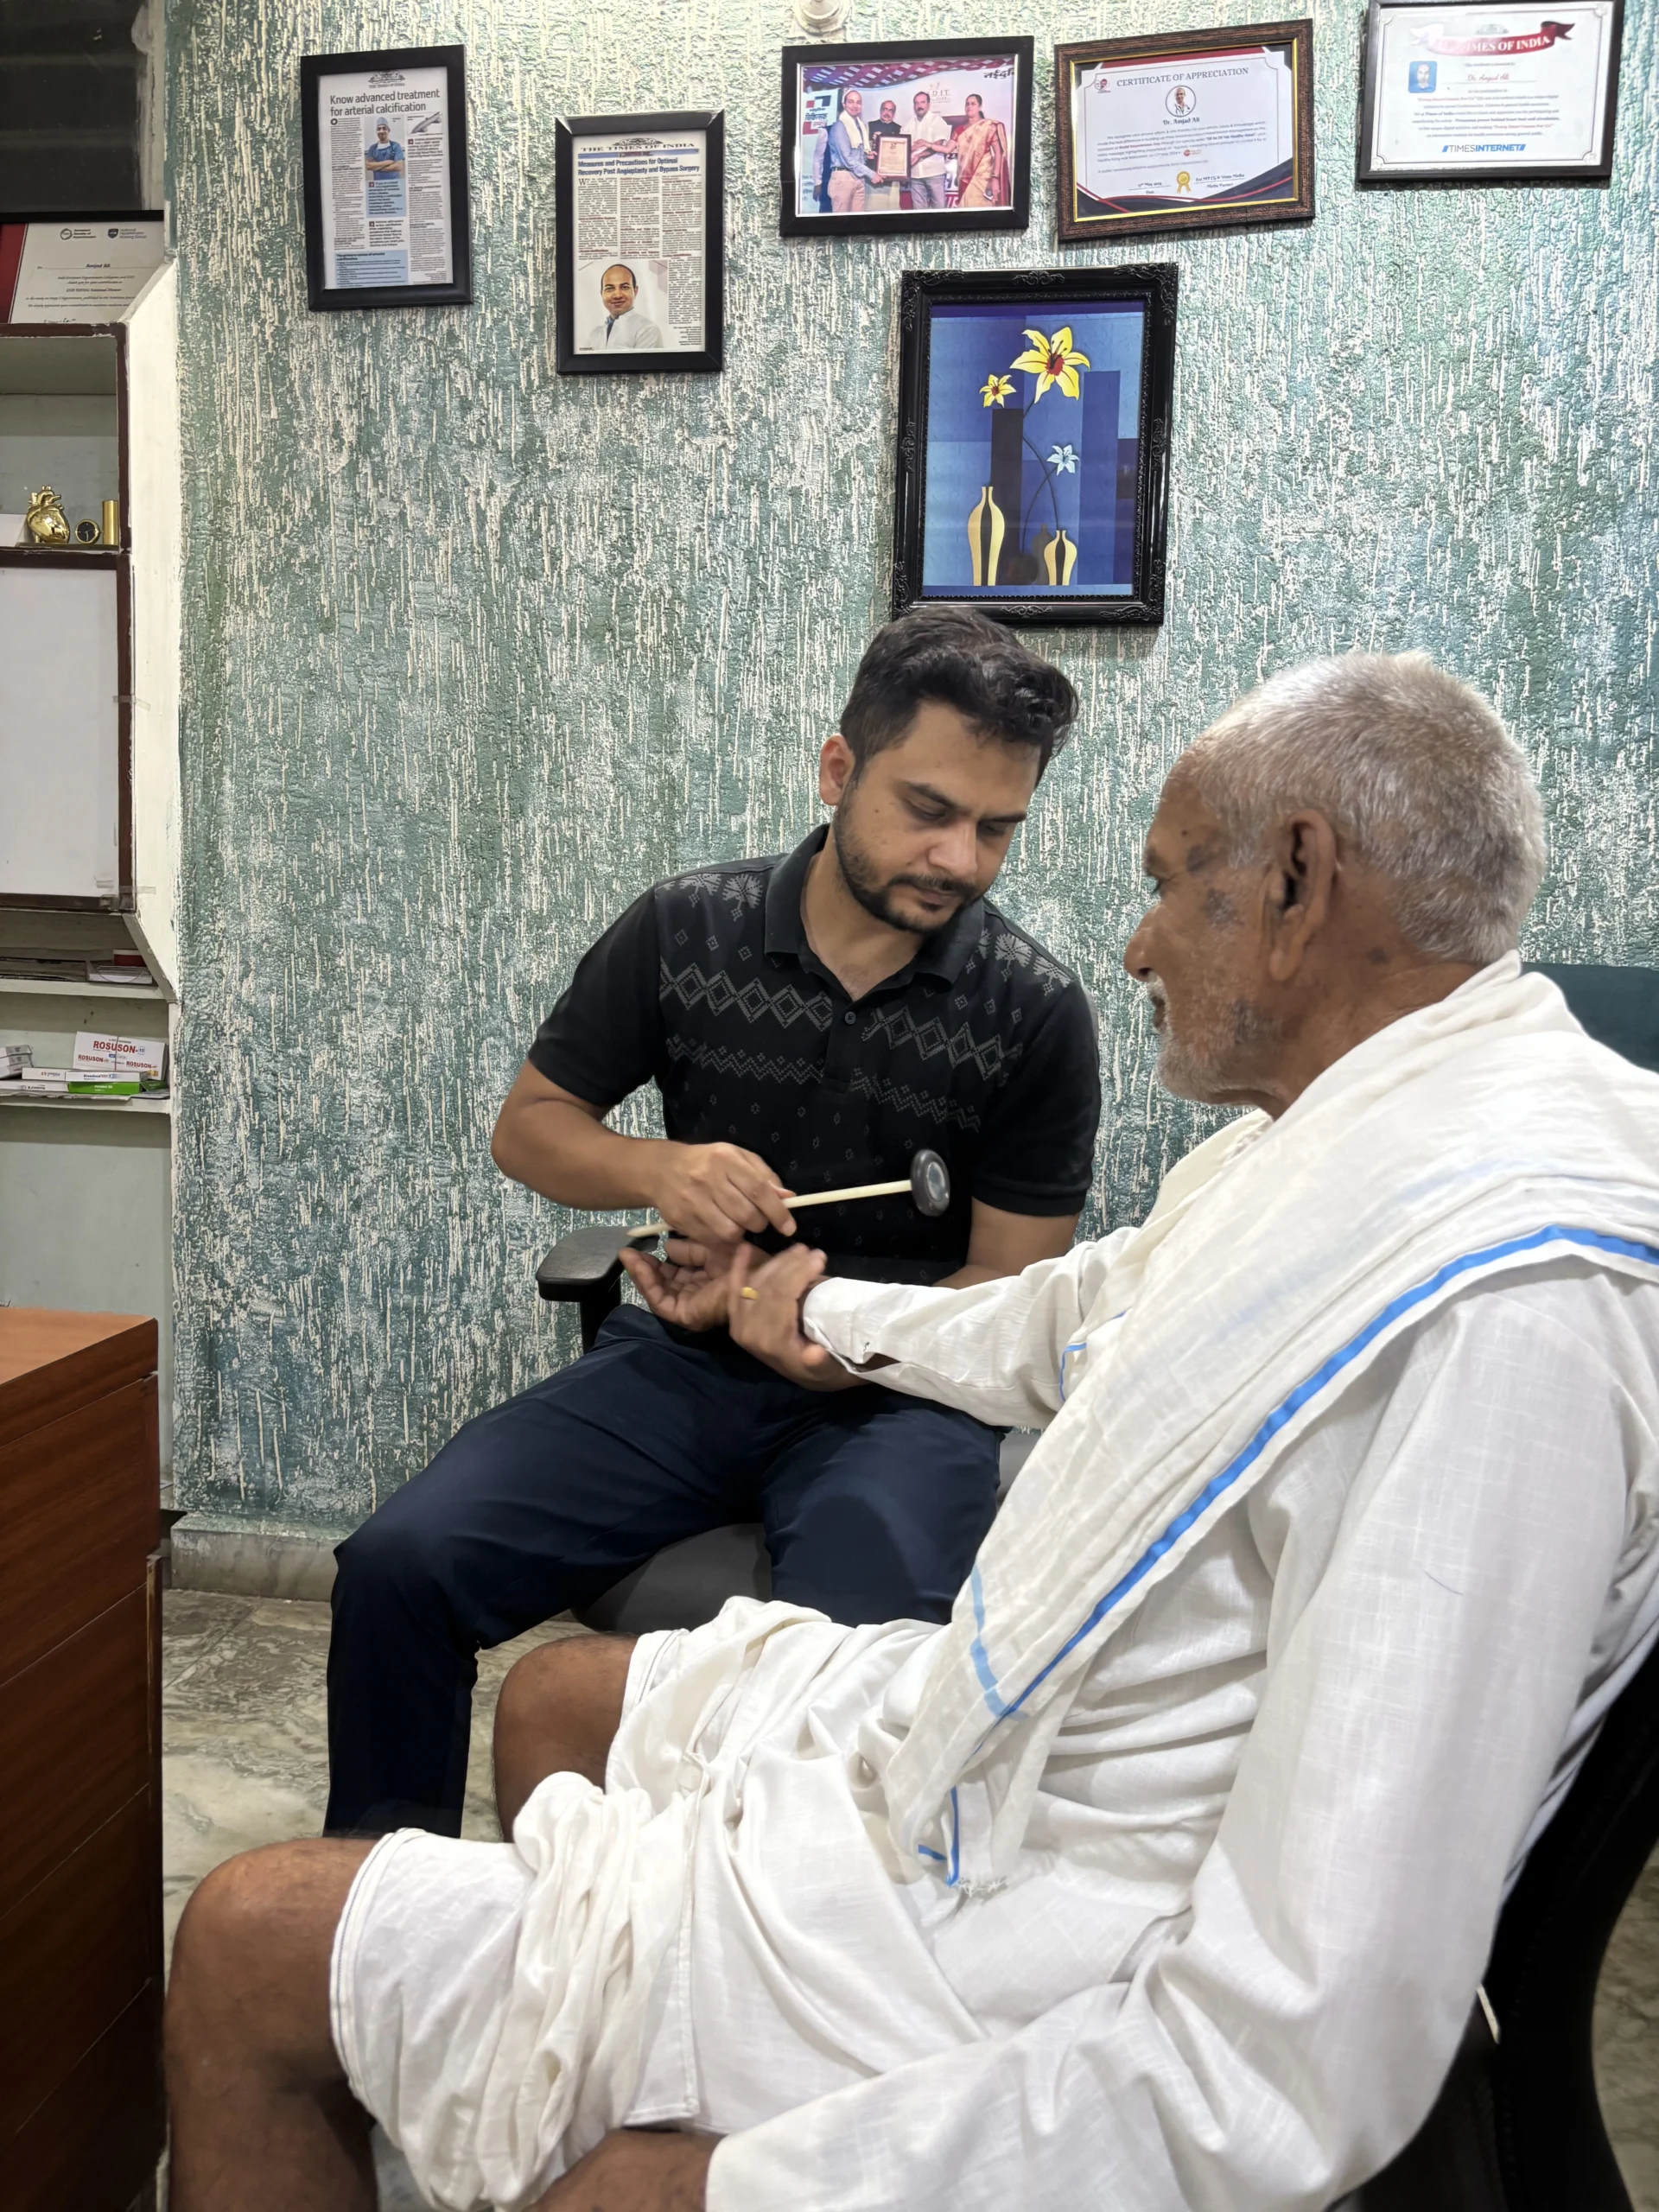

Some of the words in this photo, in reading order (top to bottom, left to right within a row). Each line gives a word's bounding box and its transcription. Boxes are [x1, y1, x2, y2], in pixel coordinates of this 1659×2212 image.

[1460, 42, 1496, 52] IMES
[1498, 41, 1513, 51] OF
[1516, 36, 1551, 50] INDIA
[1116, 75, 1171, 87] CERTIFICATE
[1185, 67, 1249, 80] APPRECIATION
[330, 95, 353, 104] Know
[355, 91, 395, 103] advanced
[397, 89, 440, 100] treatment
[330, 107, 342, 116] for
[345, 104, 374, 115] arterial
[376, 102, 426, 114] calcification
